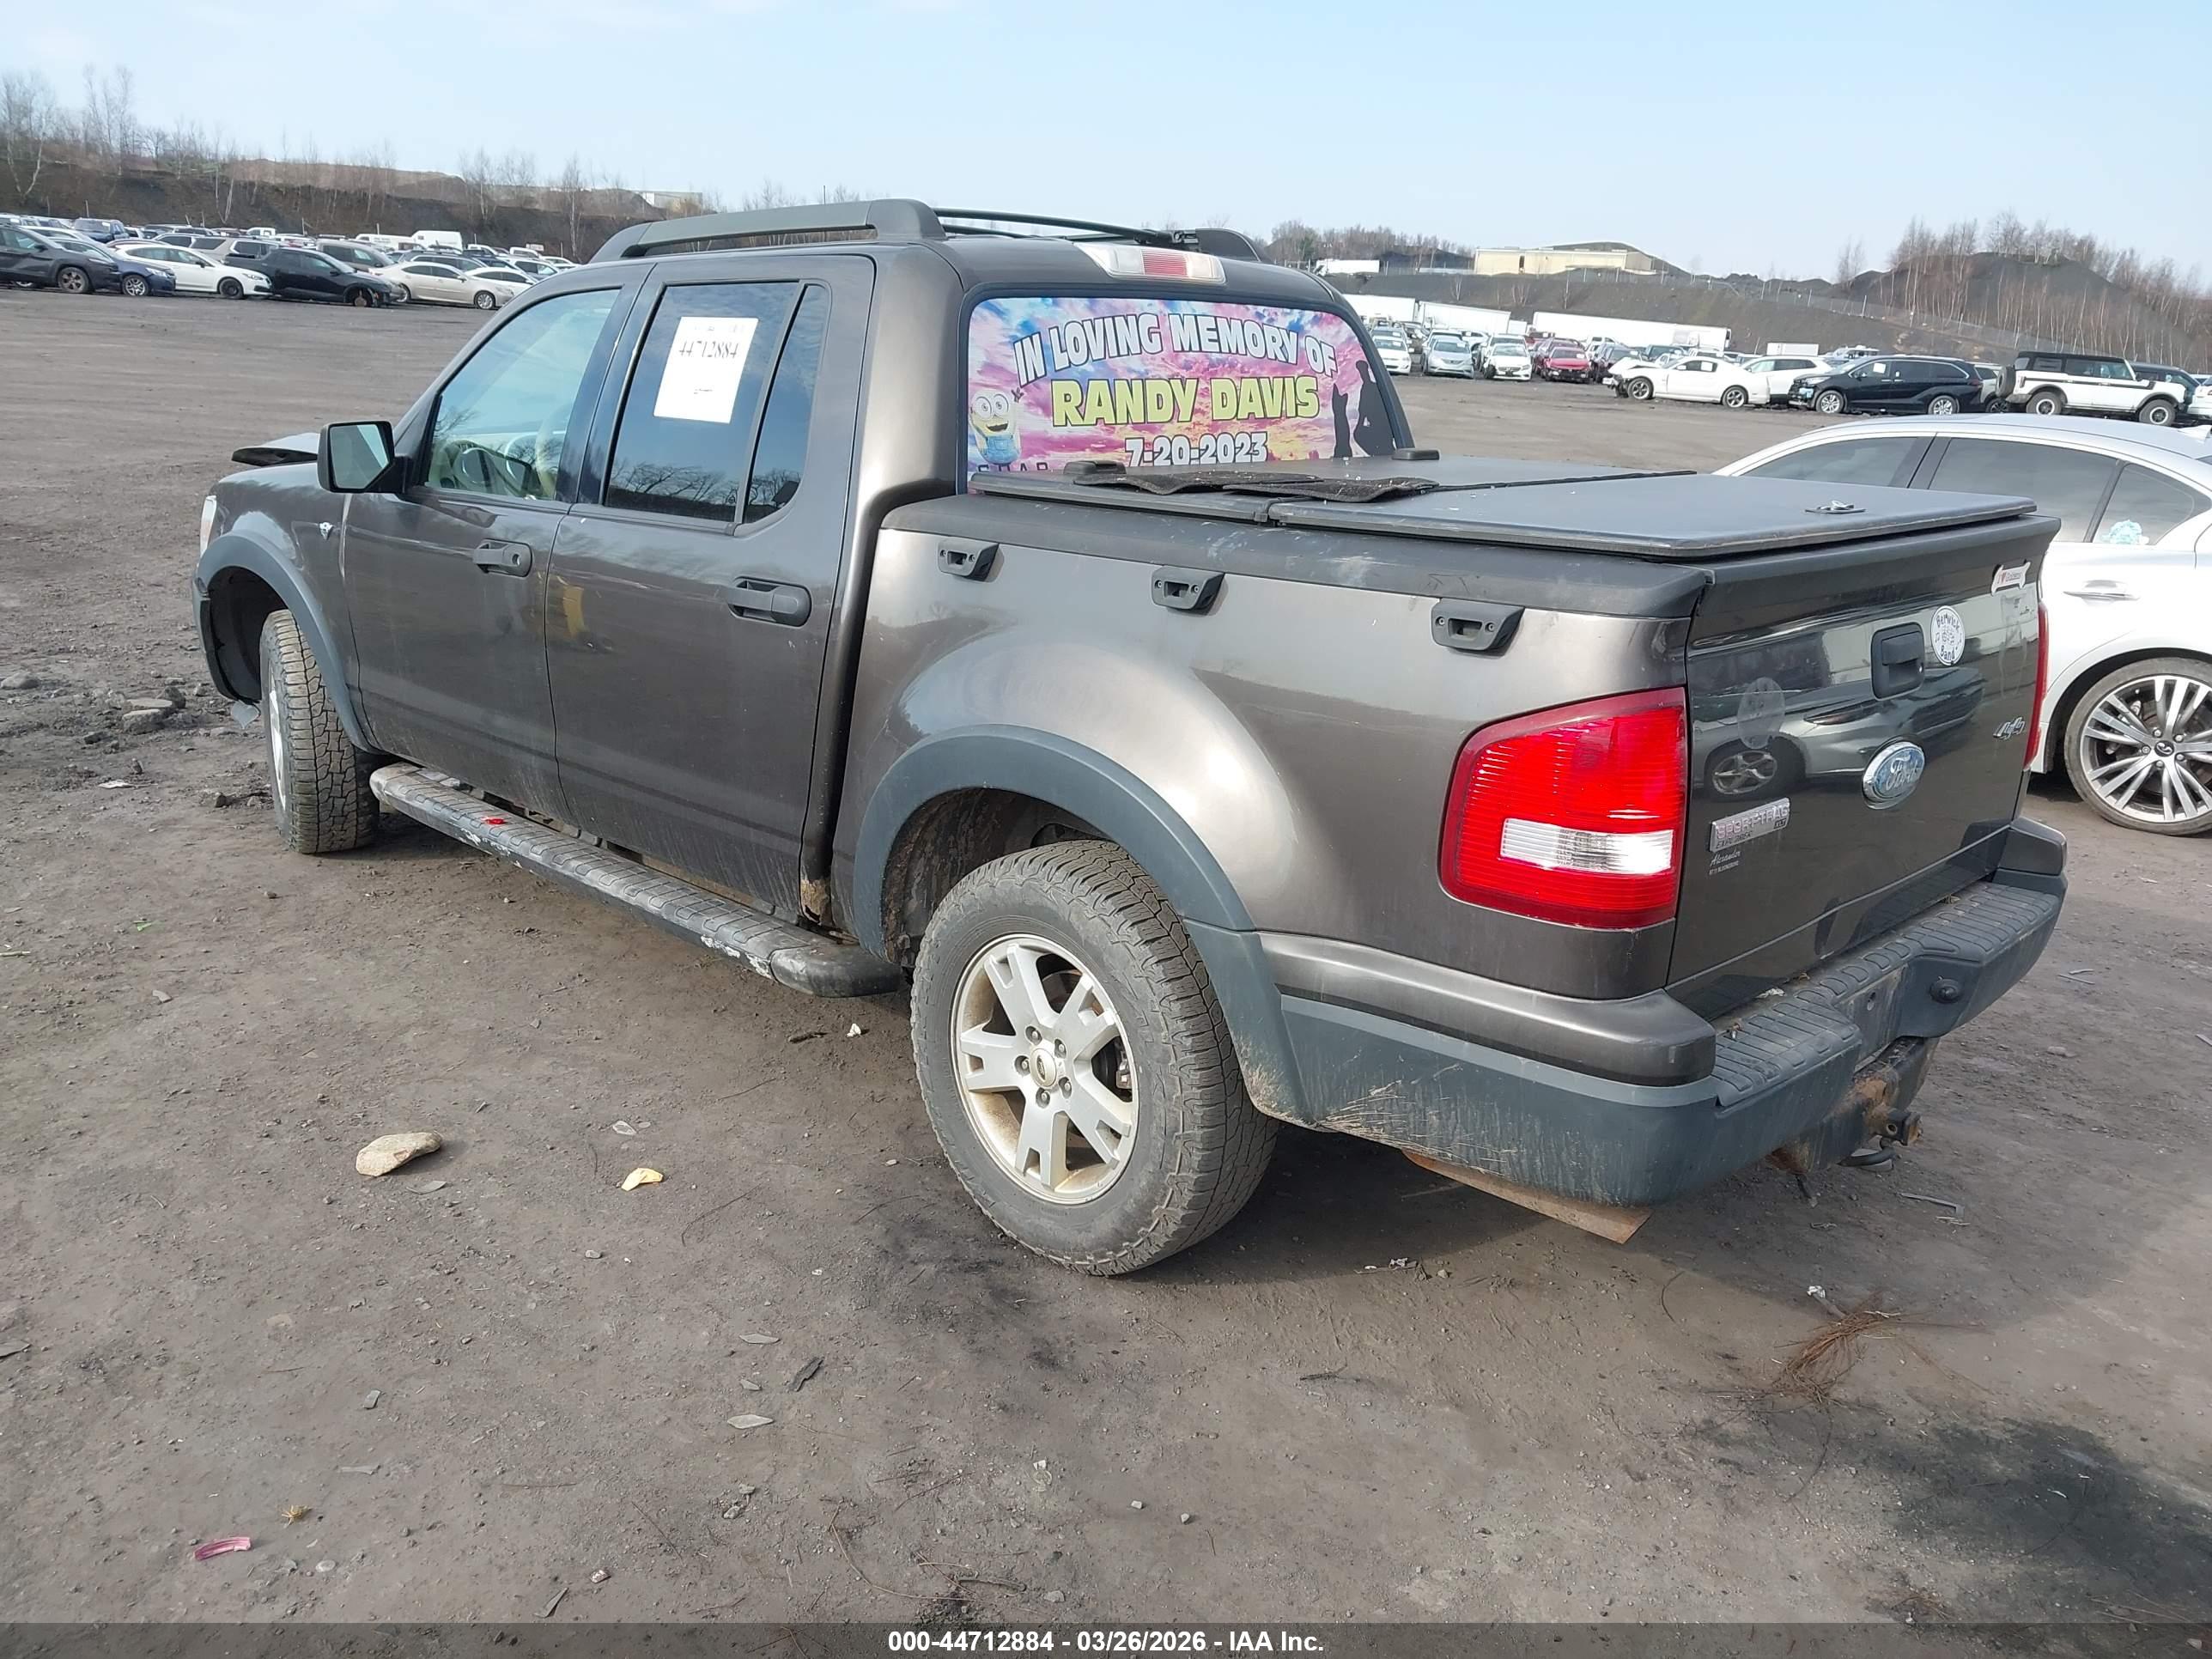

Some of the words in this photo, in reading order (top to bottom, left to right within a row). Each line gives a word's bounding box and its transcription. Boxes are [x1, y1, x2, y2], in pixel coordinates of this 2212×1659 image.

[678, 340, 739, 360] 44712884
[1013, 331, 1047, 388] IN
[1048, 313, 1164, 372] LOVING
[1168, 313, 1299, 365] MEMORY
[1304, 335, 1339, 378] OF
[1051, 379, 1199, 427] RANDY
[1210, 376, 1320, 421] DAVIS
[1125, 431, 1268, 467] 7-20-2023
[1941, 645, 1955, 660] Band
[1886, 754, 1922, 791] Ford
